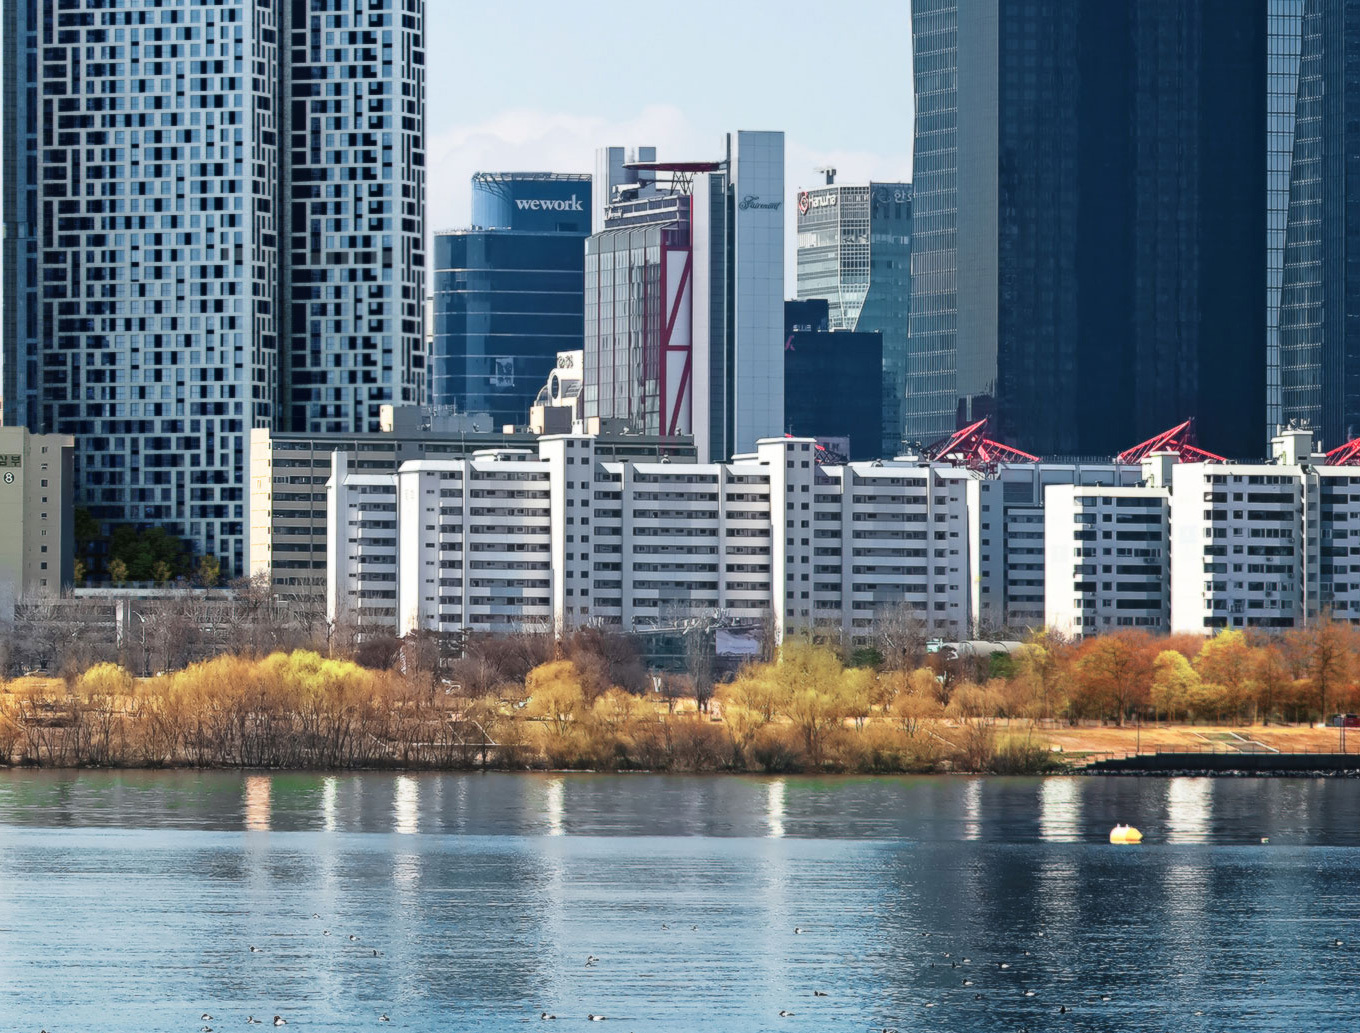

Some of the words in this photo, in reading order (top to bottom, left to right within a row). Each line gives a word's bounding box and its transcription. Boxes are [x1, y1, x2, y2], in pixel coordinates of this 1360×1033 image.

[514, 193, 584, 211] wework
[808, 192, 837, 209] Hanwha
[4, 472, 14, 484] 8
